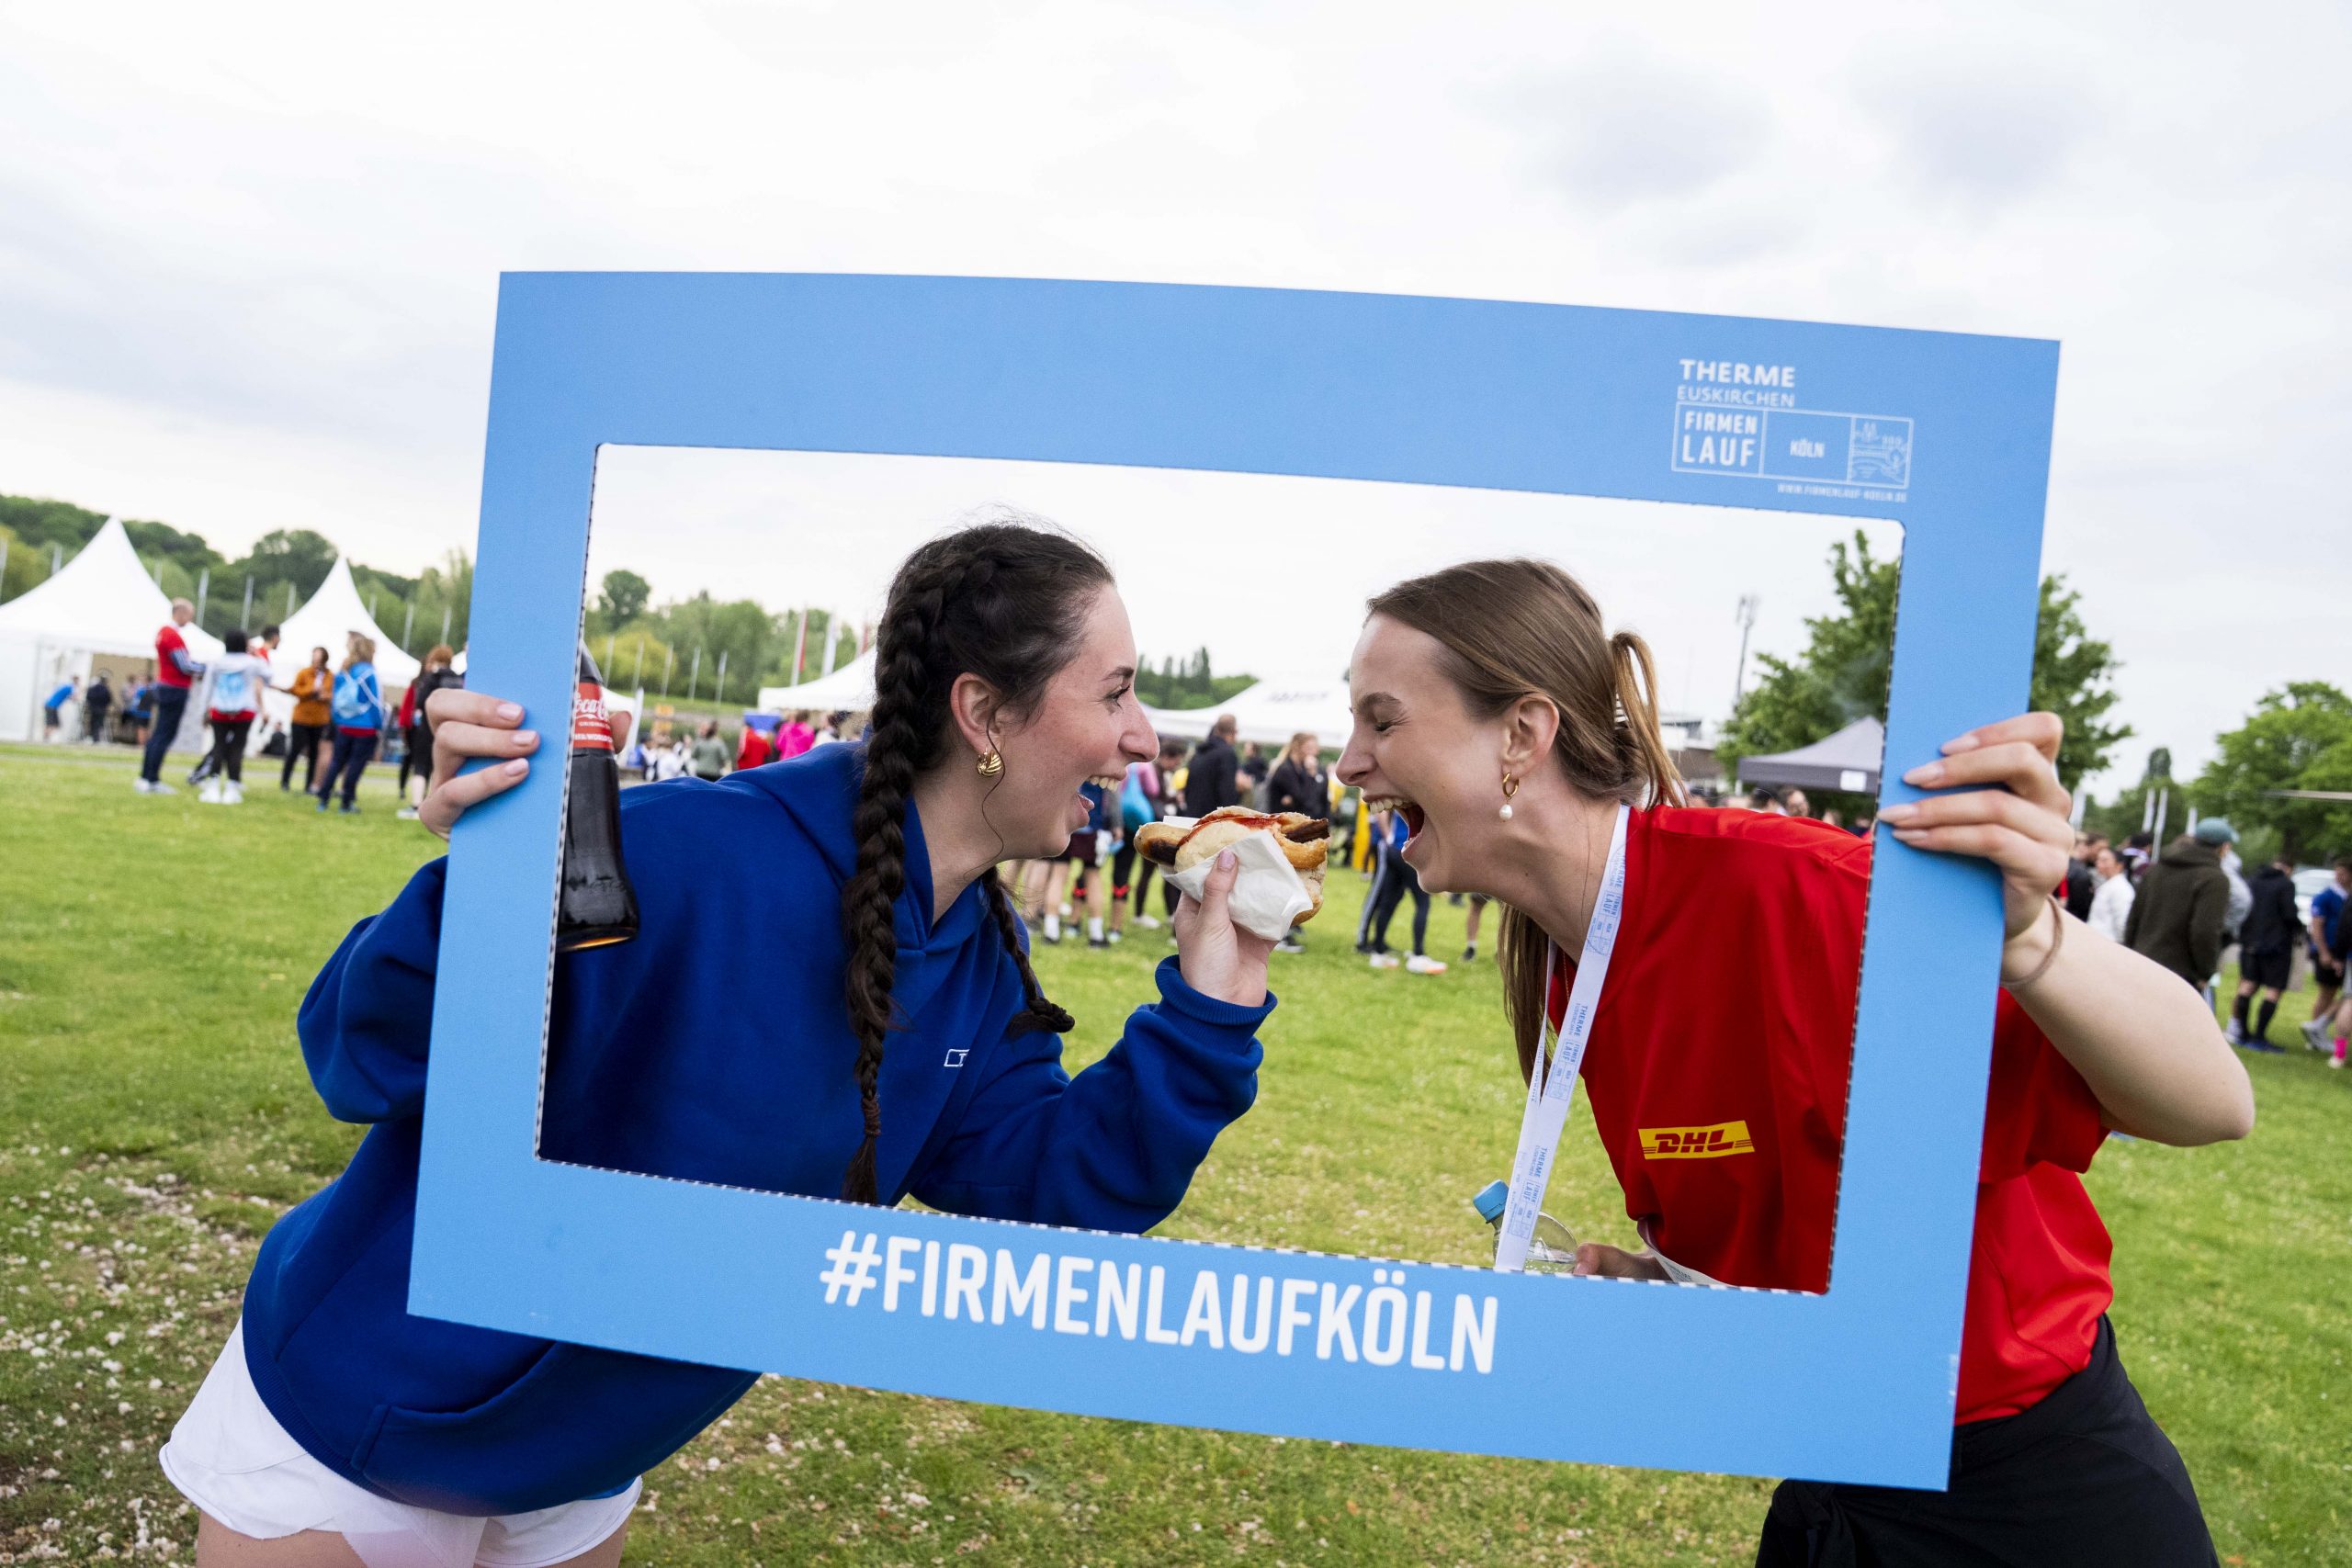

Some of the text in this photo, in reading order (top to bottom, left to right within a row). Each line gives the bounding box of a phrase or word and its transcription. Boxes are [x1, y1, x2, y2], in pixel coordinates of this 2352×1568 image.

[1679, 358, 1795, 388] THERME
[1677, 385, 1794, 407] EUSKIRCHEN
[1684, 411, 1758, 434] FIRMEN
[1682, 434, 1755, 467] LAUF
[1790, 438, 1826, 458] KÖLN
[1574, 1005, 1588, 1036] THERME
[1655, 1129, 1735, 1153] DHL
[1533, 1146, 1548, 1178] THERME
[820, 1230, 1498, 1374] #FIRMENLAUFKÖLN
